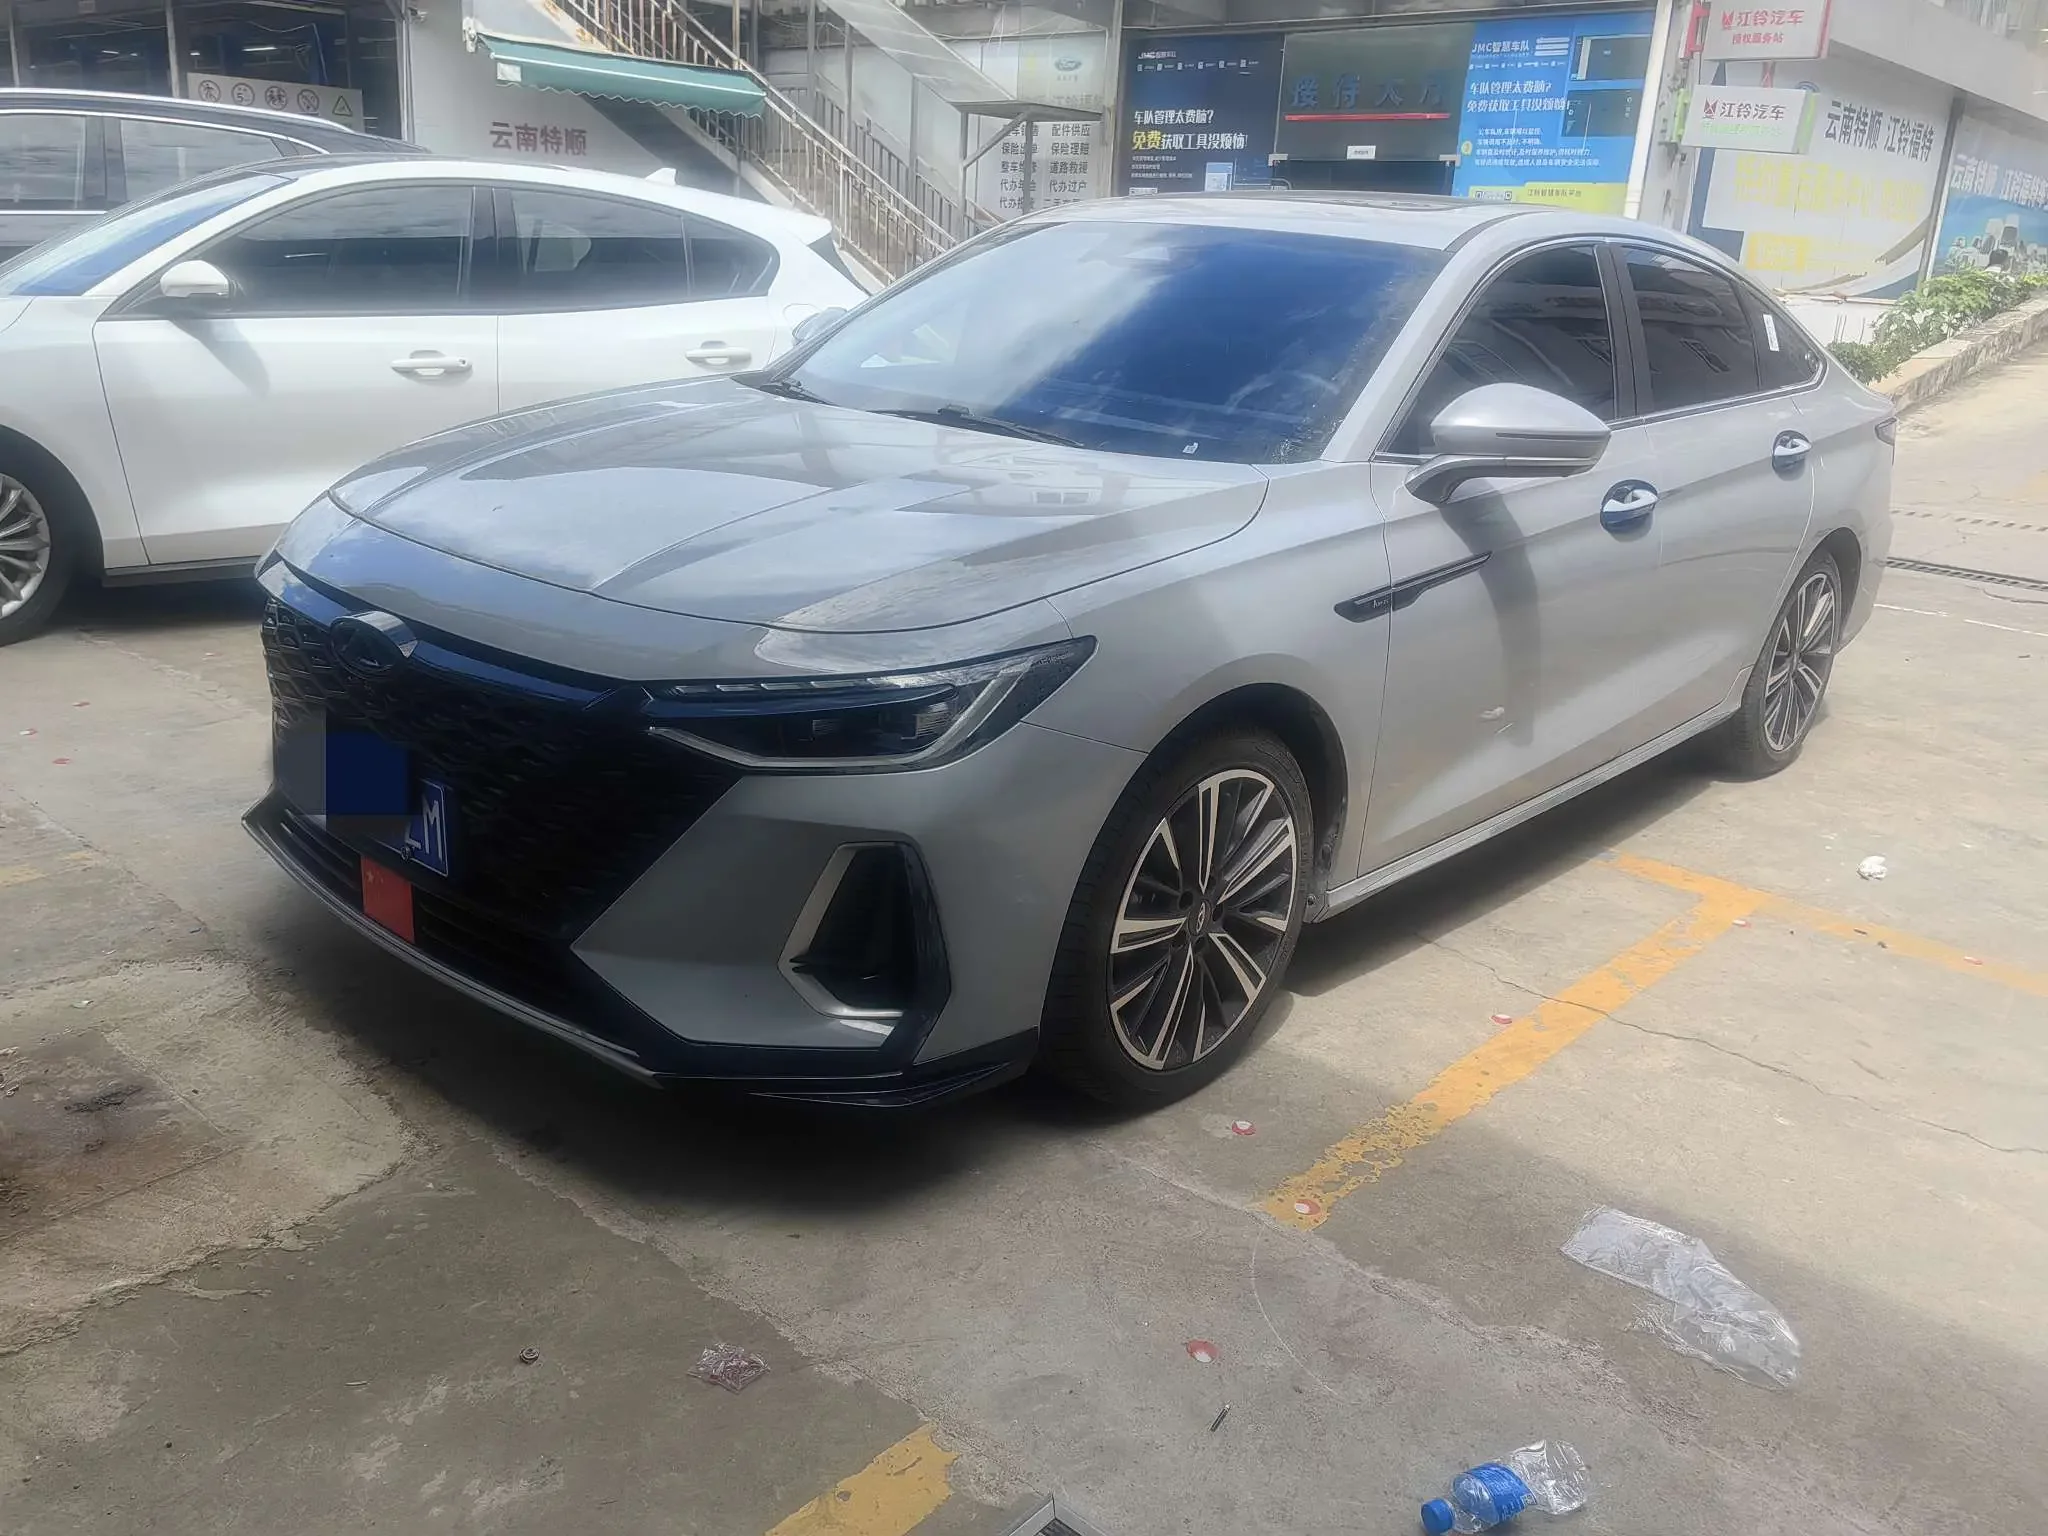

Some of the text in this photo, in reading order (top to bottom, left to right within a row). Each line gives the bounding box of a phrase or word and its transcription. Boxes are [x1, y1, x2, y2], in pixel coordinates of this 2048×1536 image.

[1736, 10, 1805, 27] 江铃汽车
[1472, 39, 1530, 54] JMC智慧车队
[1719, 102, 1787, 121] 江铃汽车
[1051, 123, 1091, 137] 配件供应
[1824, 100, 1935, 163] 云南特顺 江铃福特
[489, 121, 588, 156] 云南特顺
[1051, 142, 1090, 155] 保险理赔
[1050, 179, 1087, 192] 代办过户
